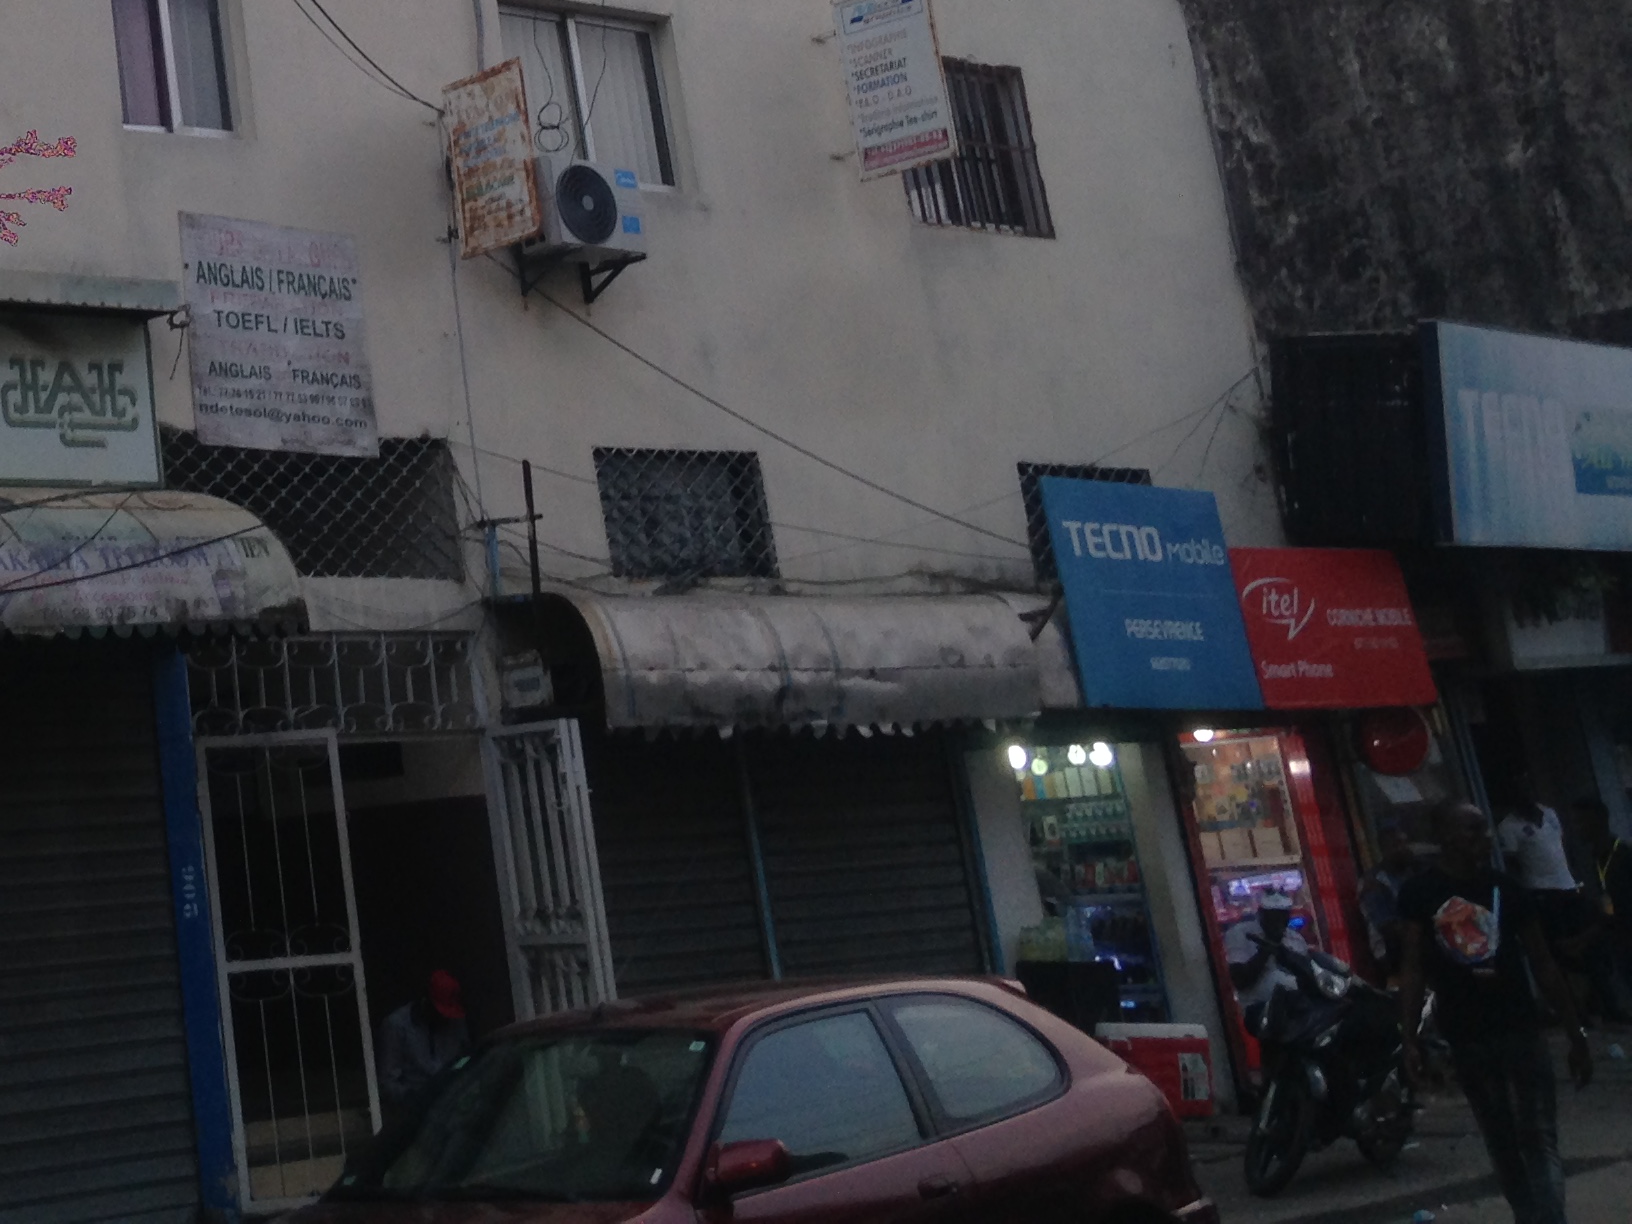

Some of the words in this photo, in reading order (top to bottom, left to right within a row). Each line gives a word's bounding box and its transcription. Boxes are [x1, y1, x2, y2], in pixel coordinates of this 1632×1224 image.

[856, 72, 908, 94] FORMATION
[196, 260, 265, 292] ANGLAIS
[277, 269, 352, 301] FRANÇAIS
[214, 309, 278, 334] TOEFL
[294, 318, 346, 341] IELTS
[208, 361, 272, 381] ANGLAIS
[291, 368, 362, 391] FRANÇAIS
[1062, 520, 1164, 563] TECNO
[1166, 537, 1226, 566] mobile
[1262, 585, 1299, 618] itel
